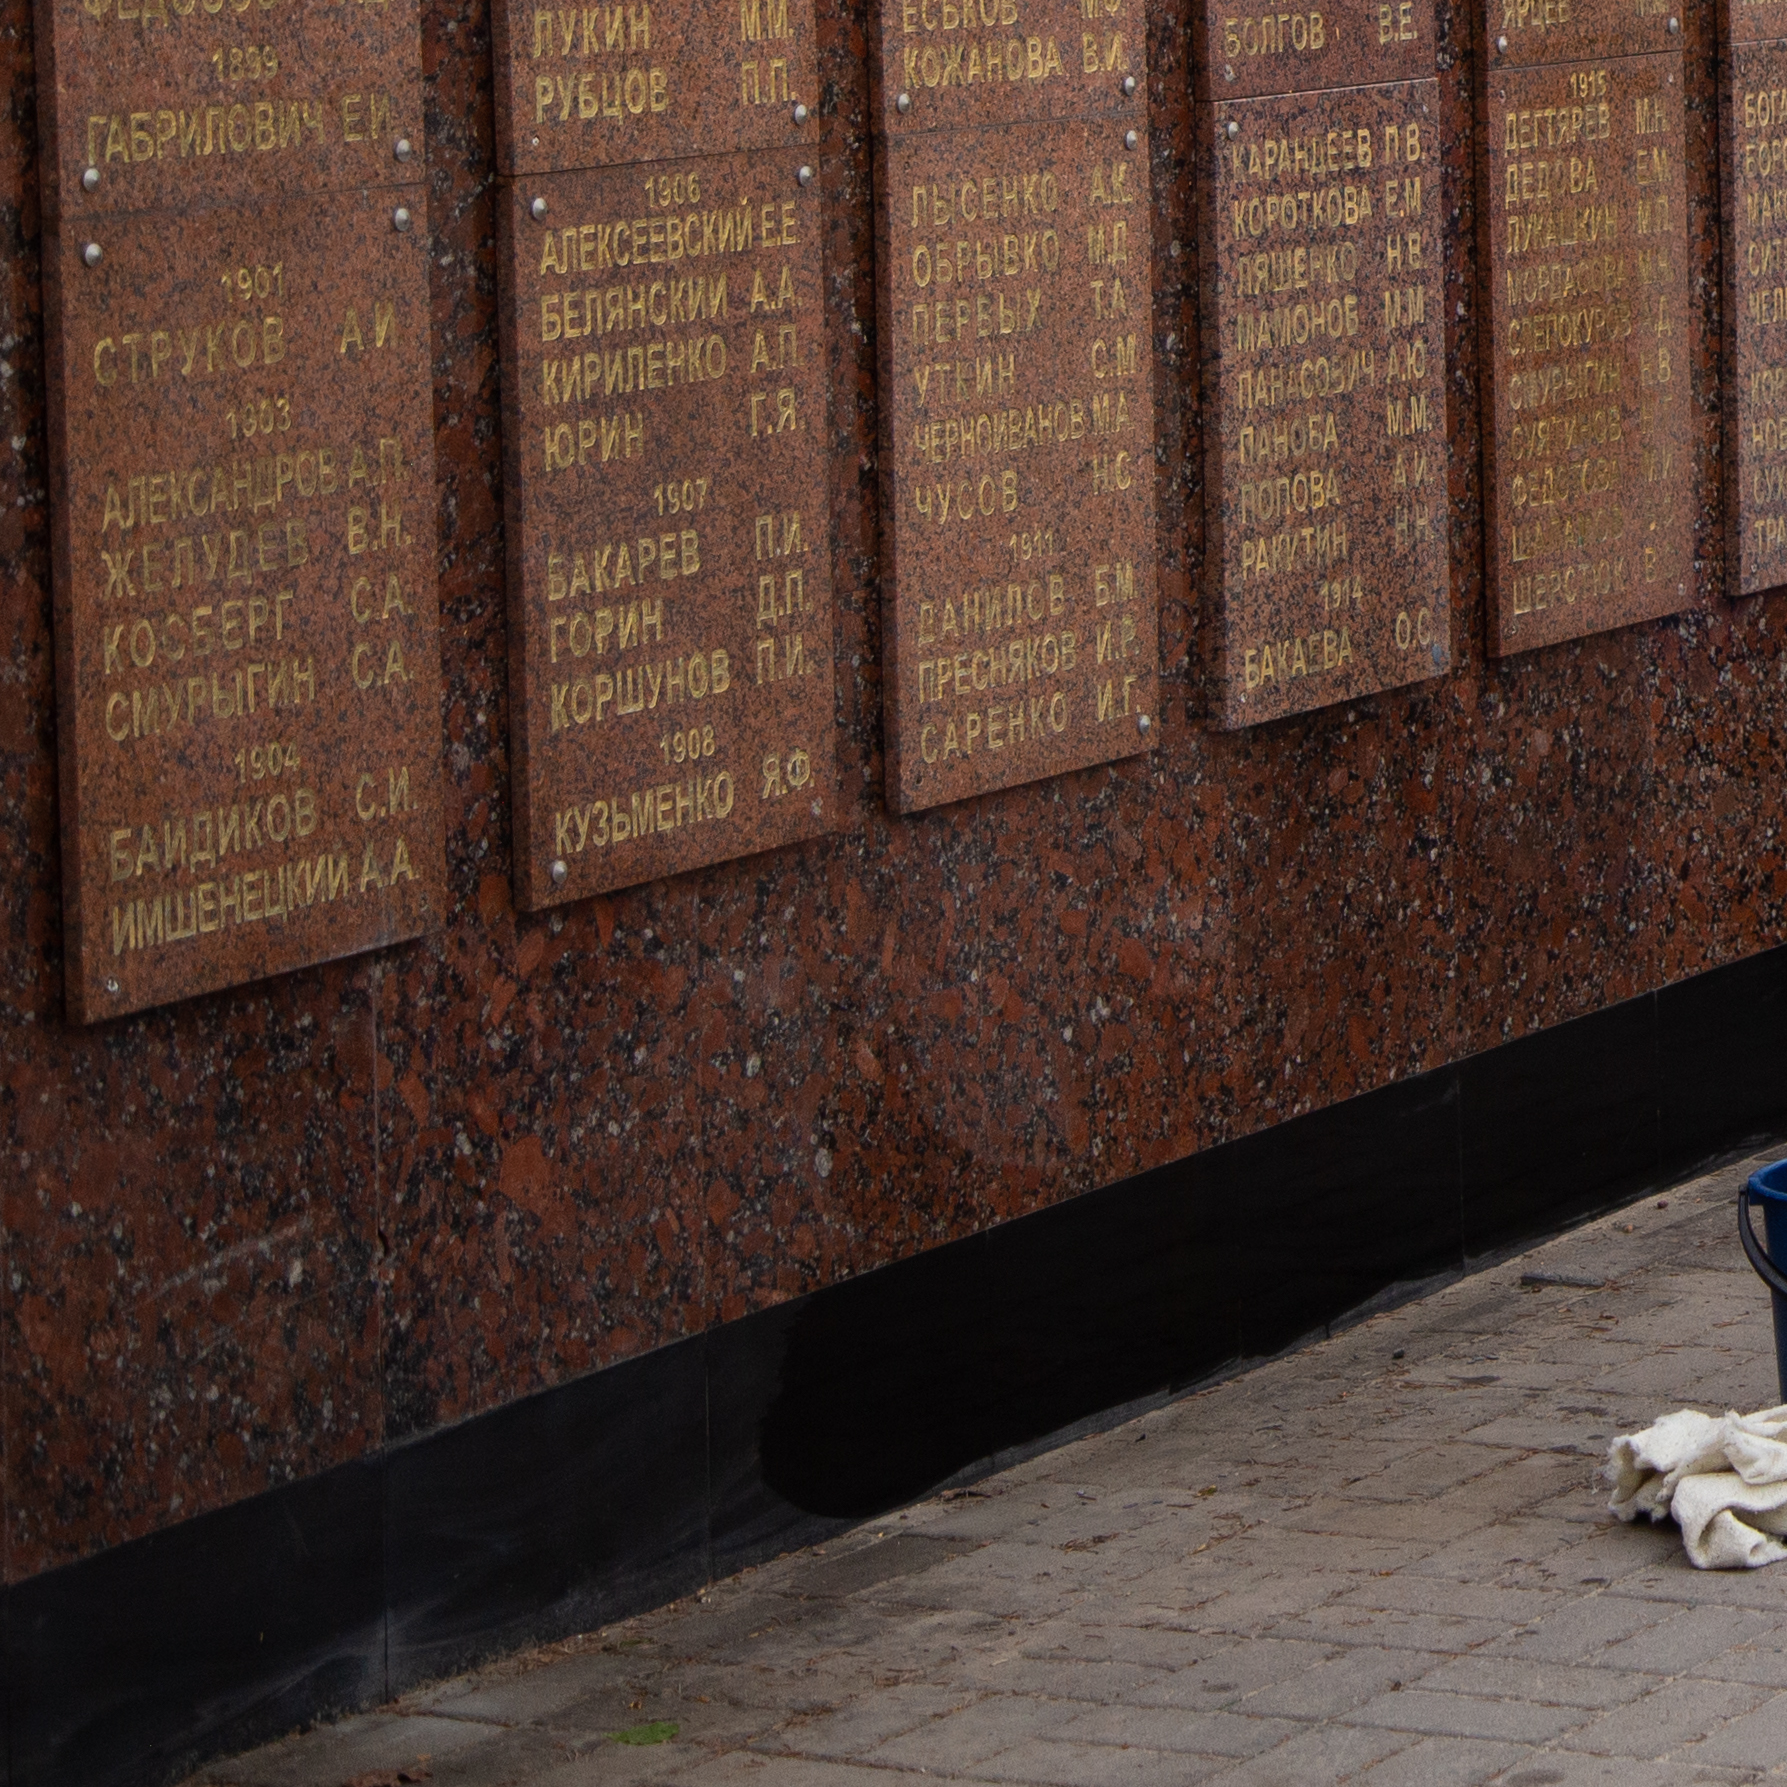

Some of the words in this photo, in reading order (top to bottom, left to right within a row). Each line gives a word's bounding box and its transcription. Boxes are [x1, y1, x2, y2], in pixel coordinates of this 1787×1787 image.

[533, 5, 650, 58] ЛУКИН
[536, 67, 669, 123] РУБЦОВ
[1570, 69, 1607, 97] 1915
[645, 172, 700, 206] 1906
[539, 196, 753, 275] АЛЕКСЕЕВСКИЙ
[221, 262, 284, 302] 1901
[541, 334, 727, 405] КИРИЛЕНКО
[544, 413, 643, 471] ЮРИН
[654, 477, 709, 514] 1907
[1008, 528, 1054, 559] 1911
[550, 600, 663, 662] ГОРИН
[551, 648, 731, 730] КОРШУНОВ
[235, 740, 301, 781] 1904
[660, 725, 715, 762] 1908
[555, 770, 735, 854] КУЗЬМЕНКО
